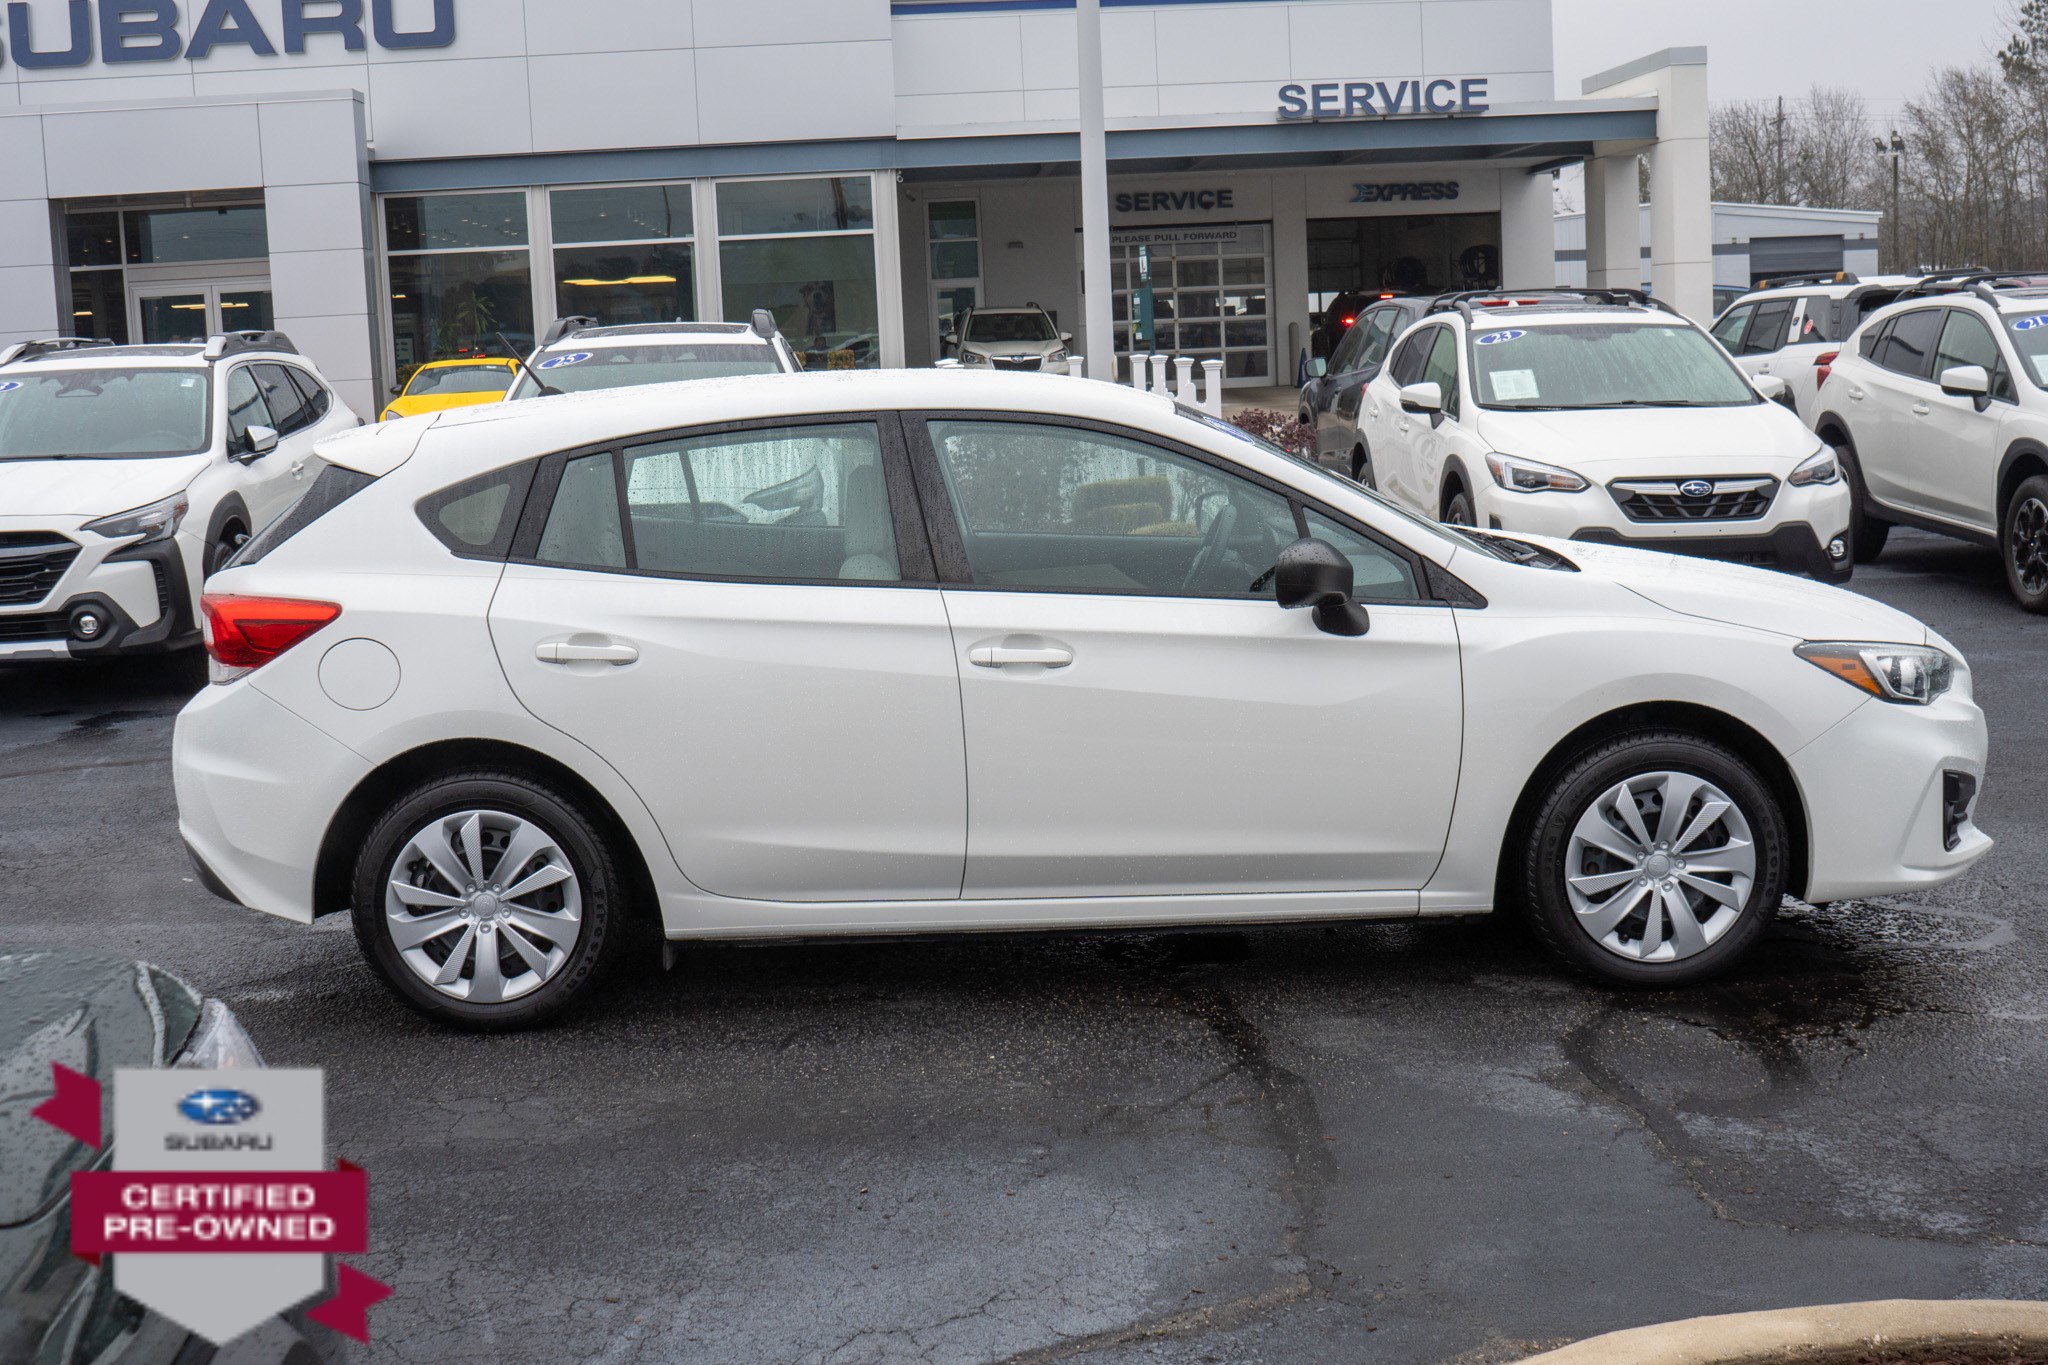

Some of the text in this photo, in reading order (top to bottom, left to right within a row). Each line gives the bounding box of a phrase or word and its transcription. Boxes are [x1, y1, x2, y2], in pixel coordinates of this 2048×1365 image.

[0, 0, 457, 70] UBARU
[1278, 78, 1490, 118] SERVICE
[1115, 190, 1234, 212] SERVICE
[1112, 231, 1237, 244] PLEASE PULL FORWARD
[2024, 316, 2044, 329] 21
[1491, 331, 1512, 343] 23
[555, 354, 577, 367] 25
